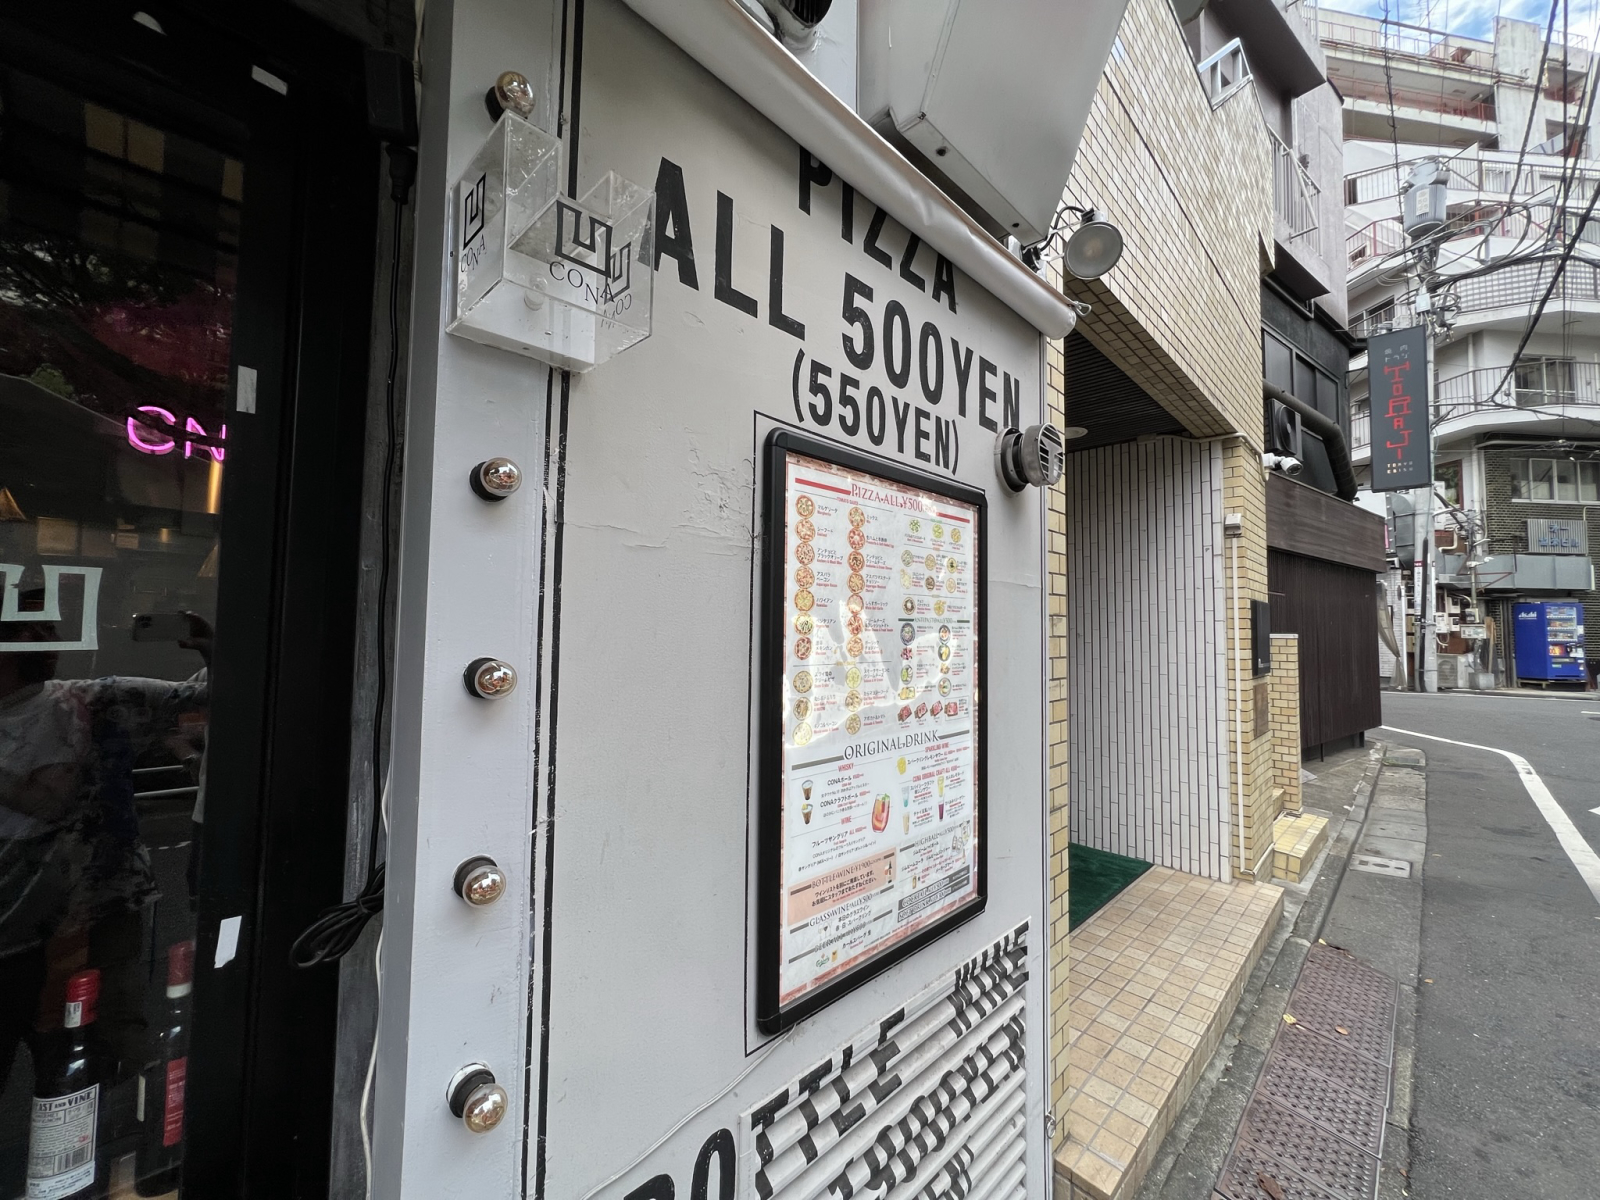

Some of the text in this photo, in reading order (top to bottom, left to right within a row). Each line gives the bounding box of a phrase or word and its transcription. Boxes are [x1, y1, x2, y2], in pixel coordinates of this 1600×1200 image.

[549, 261, 615, 305] CONA
[799, 146, 957, 315] PIZZA
[637, 157, 1020, 434] ALL 500YEN
[792, 348, 959, 477] (550YEN)
[1383, 361, 1414, 461] TORAJI
[851, 483, 880, 502] PIZZA
[844, 728, 938, 760] ORIGINAL DRINK
[622, 1007, 904, 1200] OTTLE
